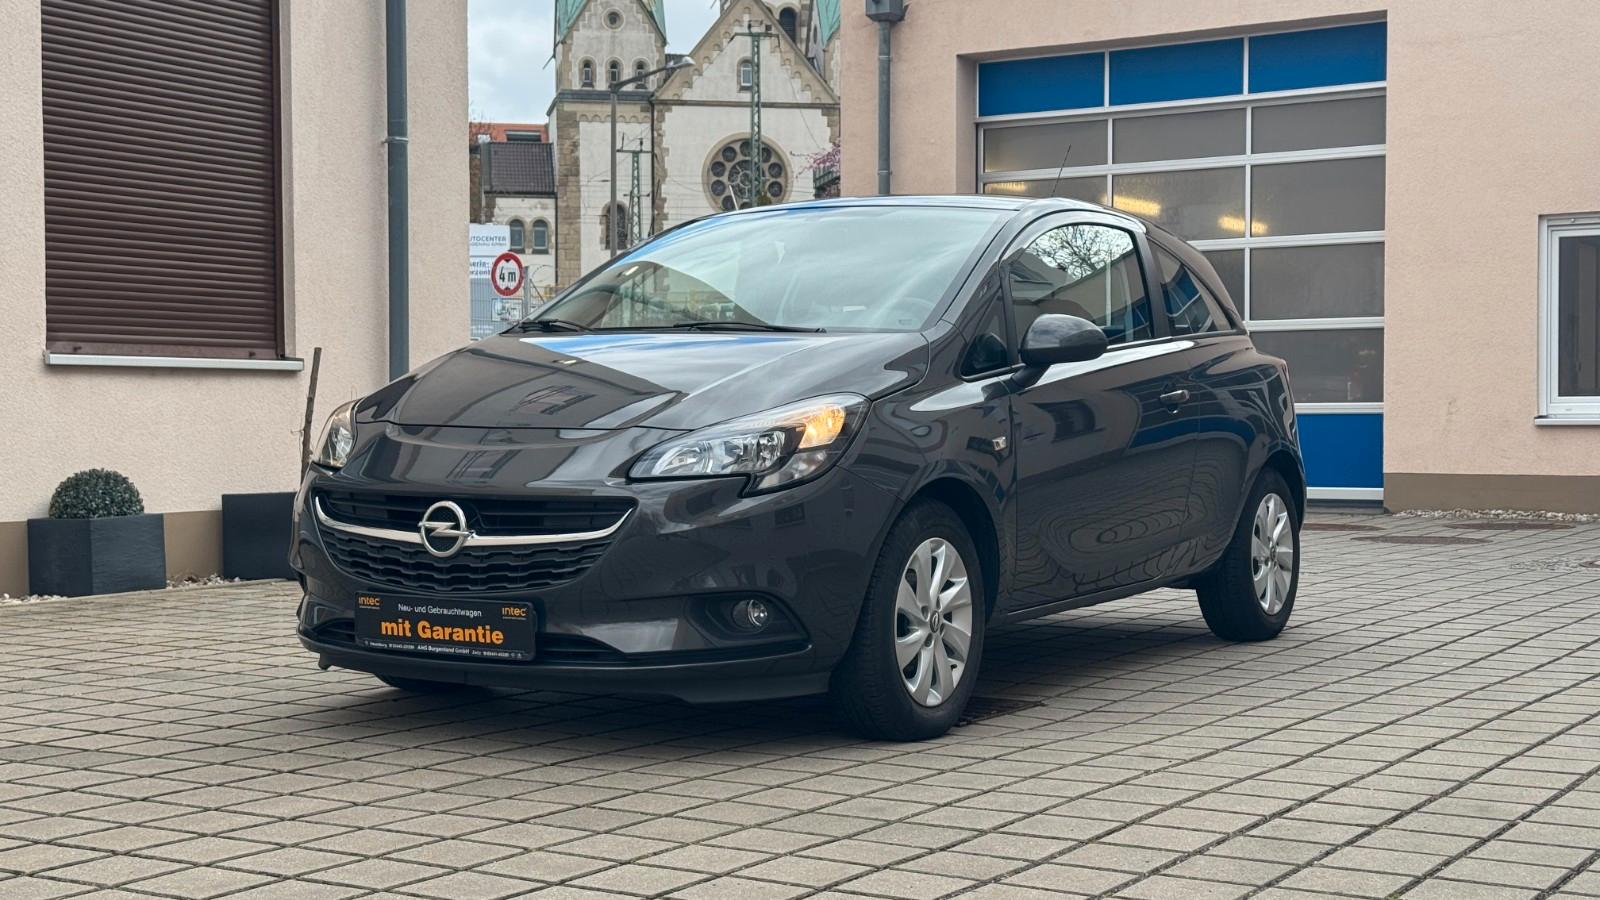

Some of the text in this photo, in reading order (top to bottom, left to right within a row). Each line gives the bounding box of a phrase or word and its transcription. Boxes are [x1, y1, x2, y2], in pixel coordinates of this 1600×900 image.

[499, 265, 516, 282] 4 m
[358, 596, 380, 606] intec
[398, 603, 482, 617] Neu- und Gebrauchtwagen
[501, 606, 527, 616] intec
[381, 618, 504, 645] mit Garantie
